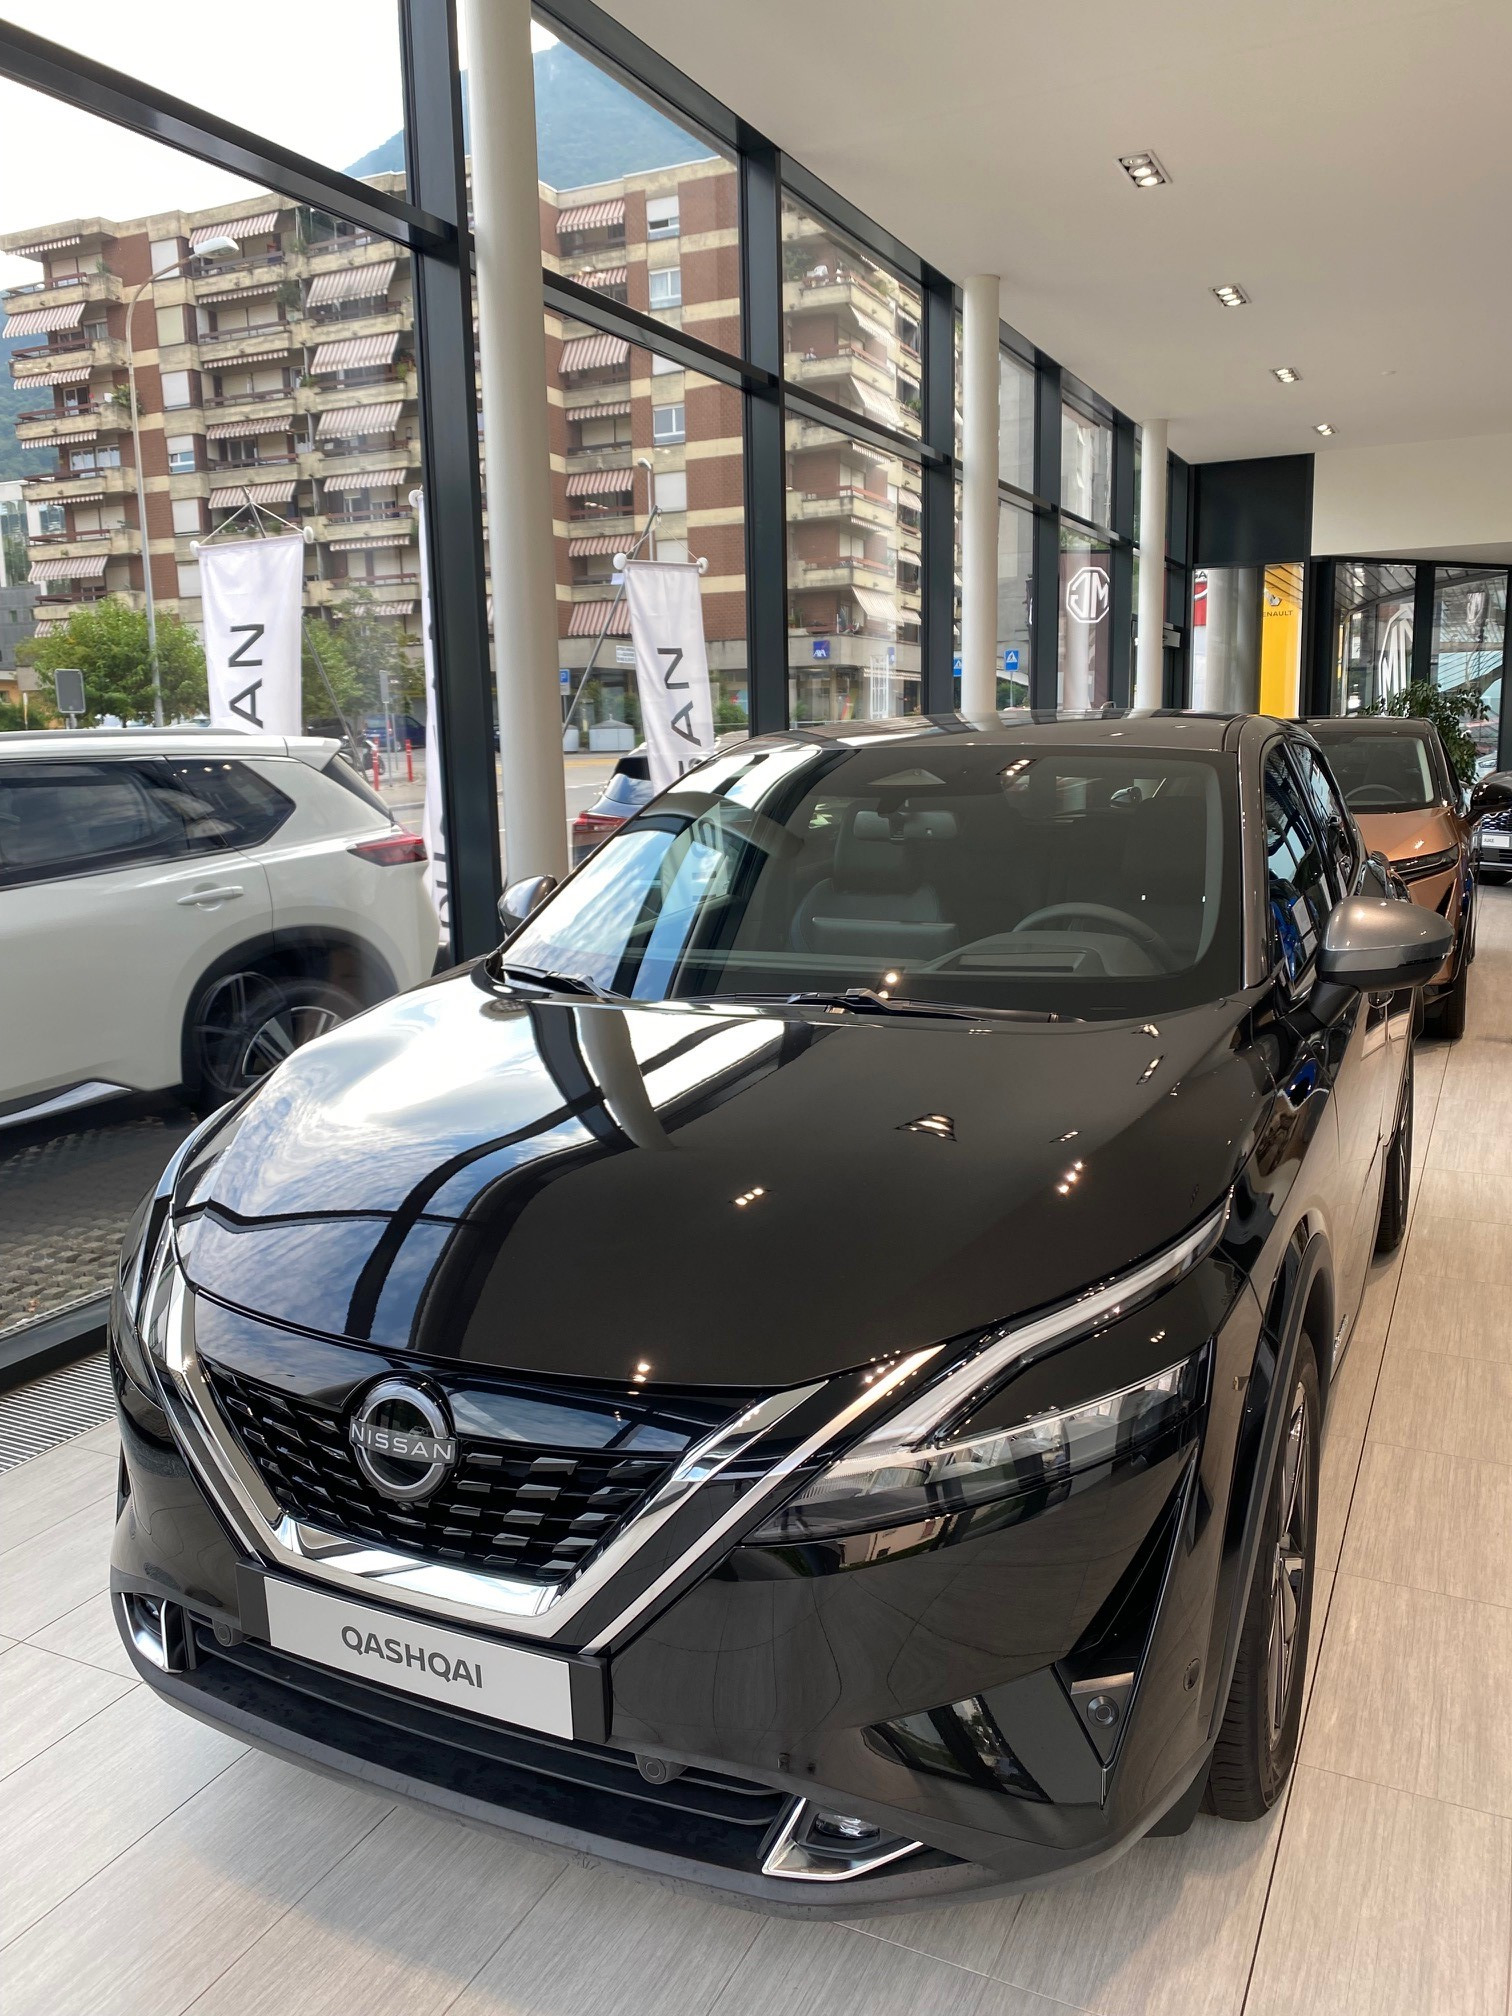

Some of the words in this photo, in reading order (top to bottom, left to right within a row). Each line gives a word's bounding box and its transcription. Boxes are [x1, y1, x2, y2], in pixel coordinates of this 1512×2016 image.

[813, 649, 827, 657] AXA
[351, 1423, 452, 1460] NISSAN
[341, 1625, 483, 1689] QASHQAI
